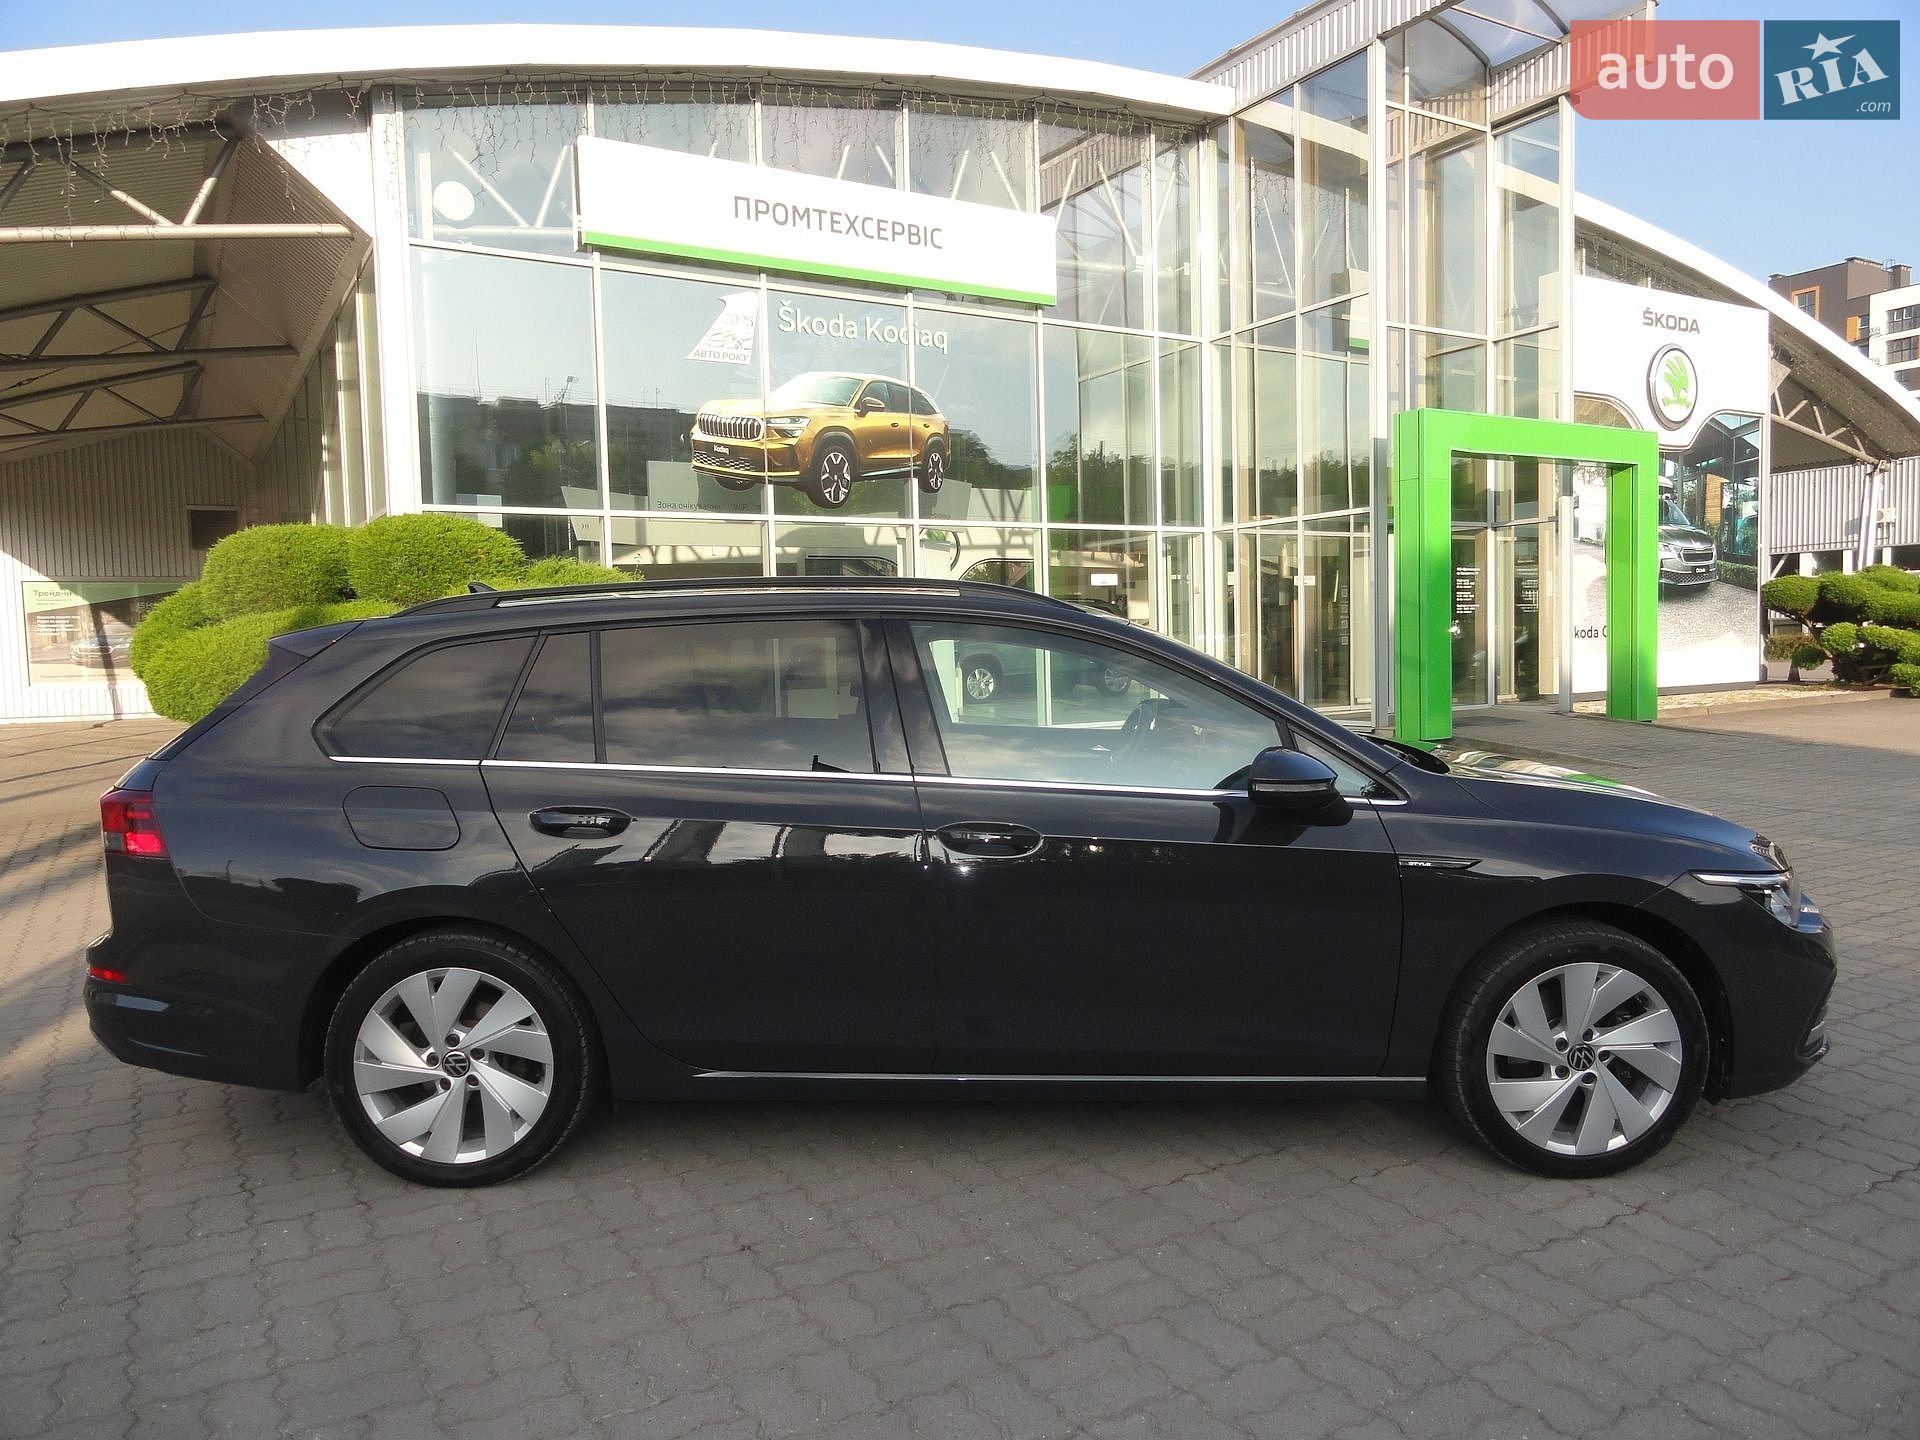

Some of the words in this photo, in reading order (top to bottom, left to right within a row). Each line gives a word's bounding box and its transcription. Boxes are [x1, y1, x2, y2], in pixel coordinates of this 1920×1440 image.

[734, 195, 943, 249] ПРОМТЕХСЕРВІС
[777, 300, 858, 340] Škoda
[1643, 307, 1700, 335] ŠKODA
[694, 349, 720, 360] АВТО
[722, 351, 749, 362] РОКУ
[1574, 625, 1599, 639] koda
